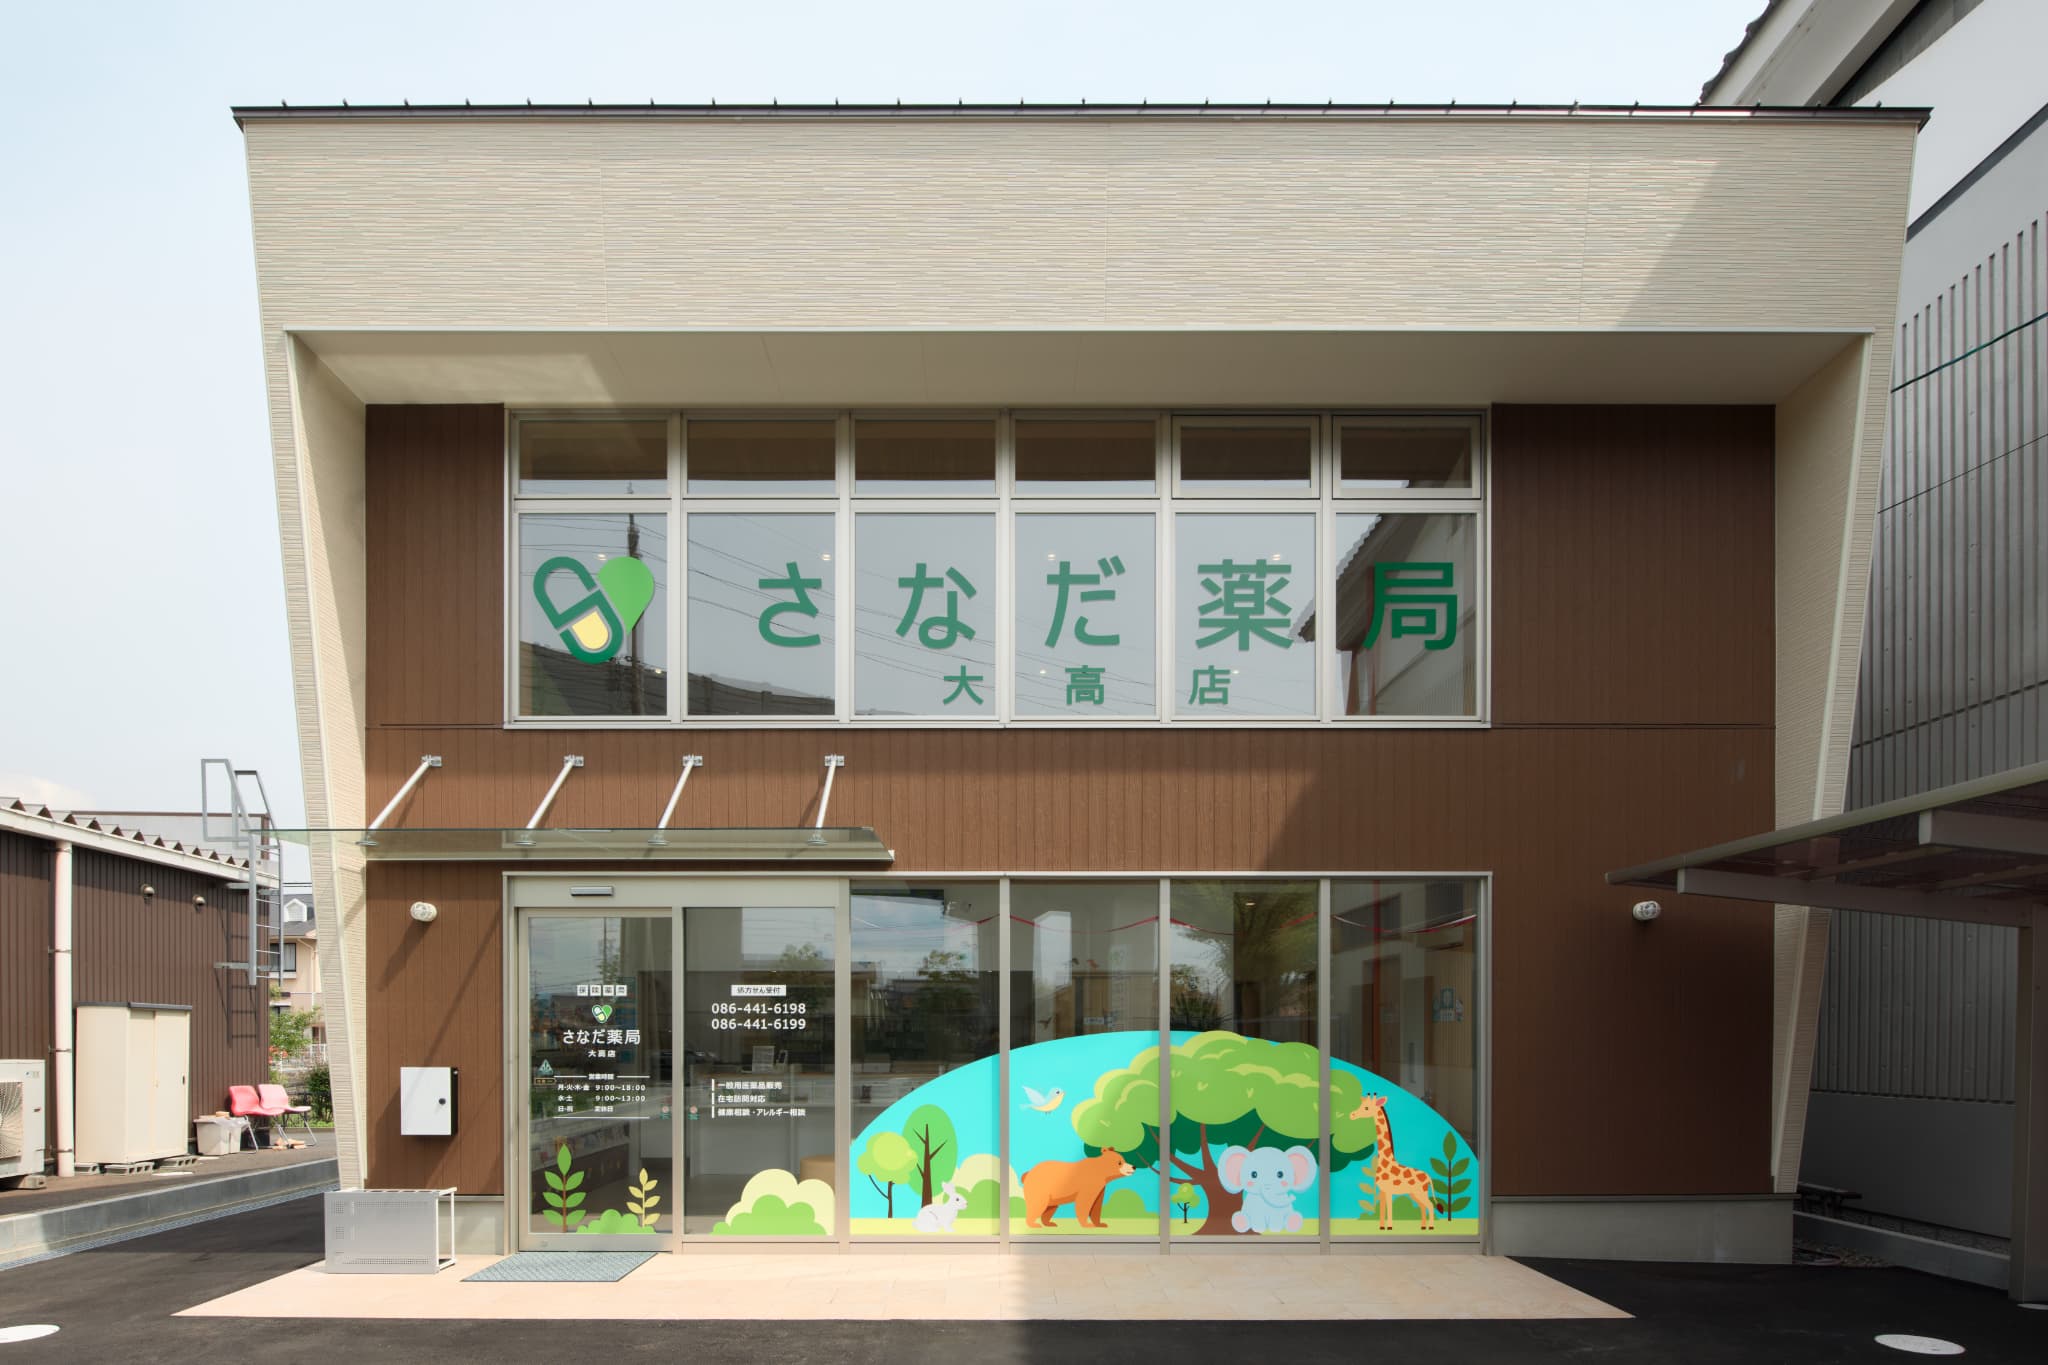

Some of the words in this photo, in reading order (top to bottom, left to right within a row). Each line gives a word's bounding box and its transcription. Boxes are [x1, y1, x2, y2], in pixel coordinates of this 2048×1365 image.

[758, 558, 1458, 651] さなだ薬局
[943, 665, 1231, 706] 大高店
[711, 1003, 806, 1014] 086-441-6198
[711, 1018, 806, 1030] 086-441-6199
[563, 1029, 641, 1045] さなだ薬局
[588, 1050, 616, 1058] 大高店
